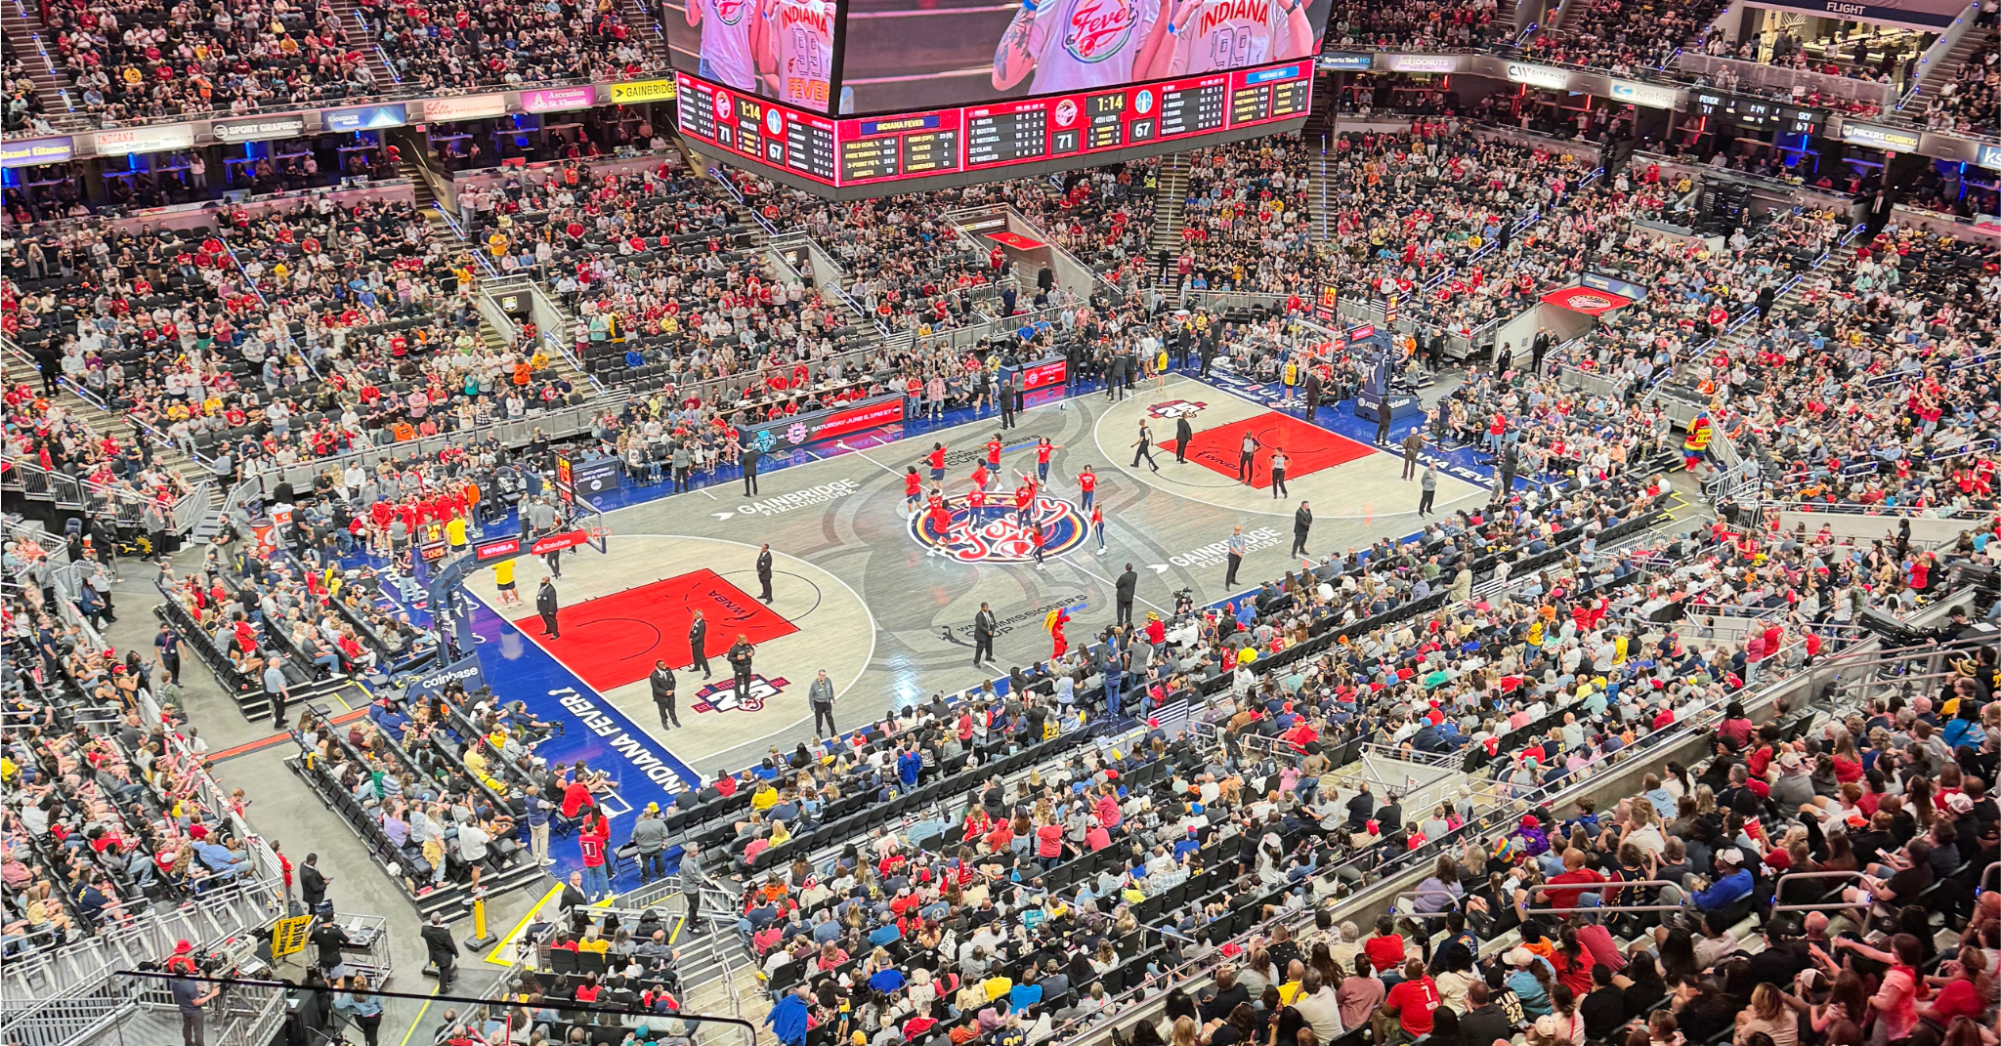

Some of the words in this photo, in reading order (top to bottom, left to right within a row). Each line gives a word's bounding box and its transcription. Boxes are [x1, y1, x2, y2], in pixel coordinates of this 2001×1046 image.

[1827, 2, 1866, 15] FLIGHT
[781, 7, 828, 37] INDIANA
[1200, 1, 1268, 38] INDIANA
[1417, 58, 1449, 66] DONUTS
[548, 89, 585, 99] Ascension
[626, 82, 678, 97] GAINBRIDGE
[786, 77, 830, 103] FEVER
[1636, 88, 1674, 102] Kinetico
[425, 101, 452, 115] Lilly
[559, 98, 587, 106] Vincent
[1097, 95, 1123, 112] 1:14
[1699, 95, 1719, 105] FEVER
[740, 101, 761, 121] 1:14
[1702, 105, 1713, 114] 71
[1797, 112, 1812, 121] SKY
[228, 124, 258, 135] SPORT
[259, 120, 303, 132] GRAPHICS
[876, 120, 904, 131] INDIANA
[903, 119, 925, 127] FEVER
[1135, 122, 1151, 137] 67
[1796, 122, 1808, 131] 67
[97, 131, 134, 145] INDIANA
[718, 125, 731, 143] 71
[1057, 133, 1073, 149] 71
[1853, 128, 1886, 140] PACERS
[1885, 133, 1918, 146] GAMING
[768, 143, 783, 160] 67
[811, 419, 845, 432] SATURDAY
[845, 414, 864, 425] JUNE
[582, 467, 610, 476] SATURDAY
[737, 478, 861, 515] GAINBRIDGE
[760, 488, 858, 517] FIELDHOUSE
[482, 542, 515, 556] WNBA
[708, 590, 746, 616] WNBA
[422, 666, 479, 689] coinbase
[547, 686, 622, 738] FEVER!
[609, 732, 693, 796] INDIANA
[281, 921, 292, 937] SOME
[289, 920, 308, 948] NOISE
[278, 937, 288, 954] MAKE
[1421, 985, 1431, 1001] 7
